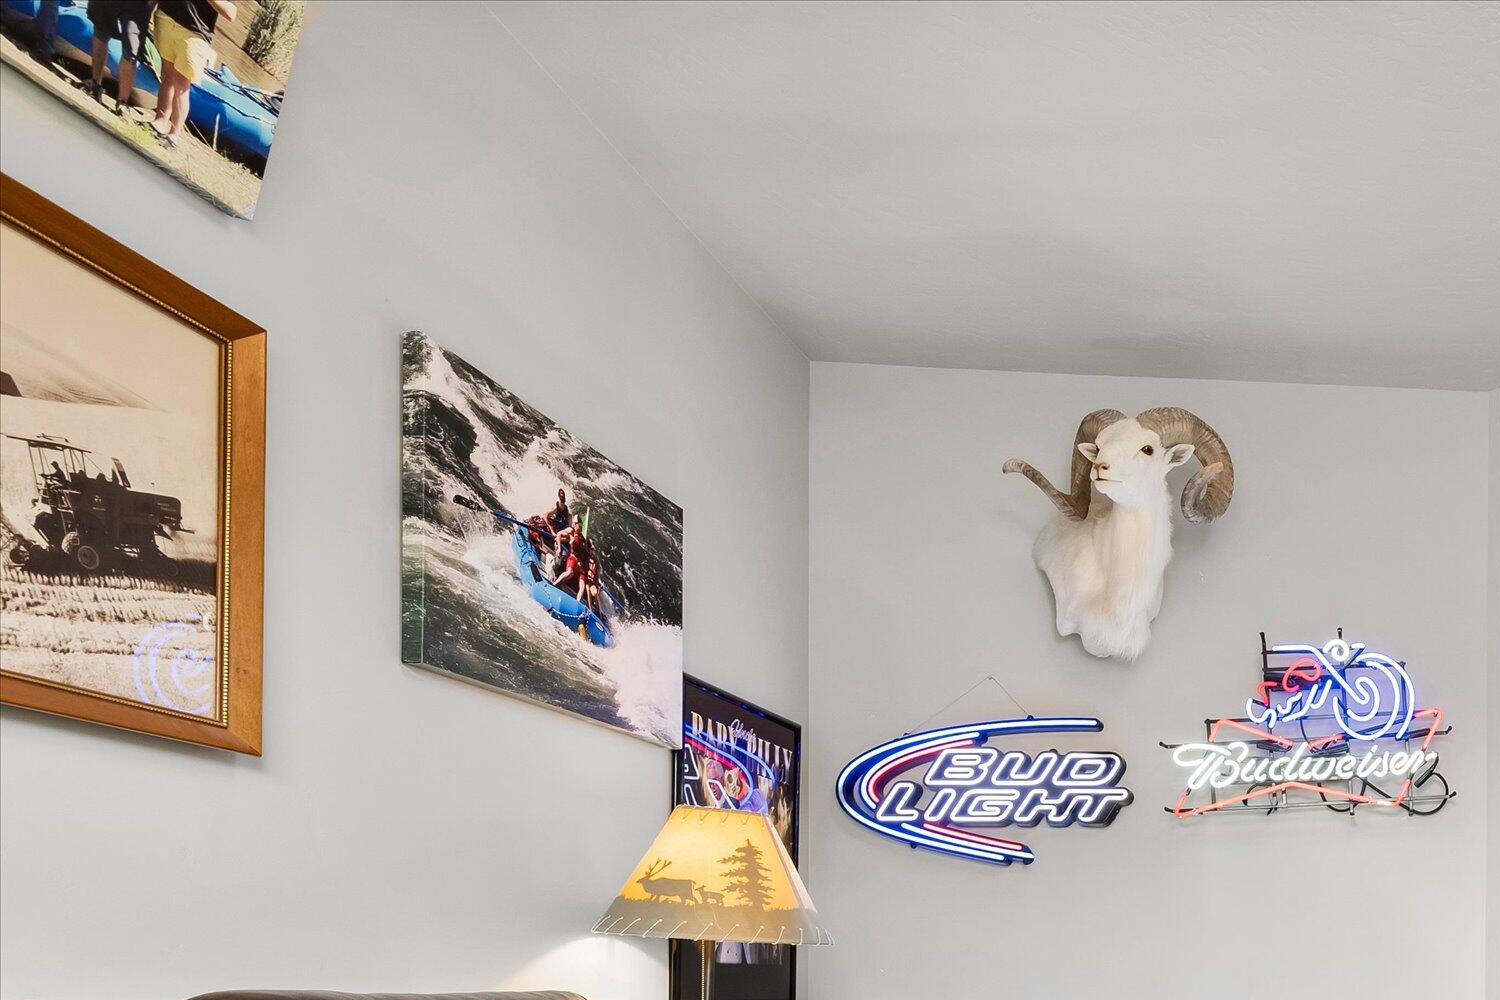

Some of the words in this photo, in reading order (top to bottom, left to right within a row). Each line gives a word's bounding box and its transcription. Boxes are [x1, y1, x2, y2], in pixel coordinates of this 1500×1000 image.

[924, 747, 1122, 787] BUD
[1172, 741, 1439, 790] Budweiser
[876, 781, 1130, 822] LIGHT
